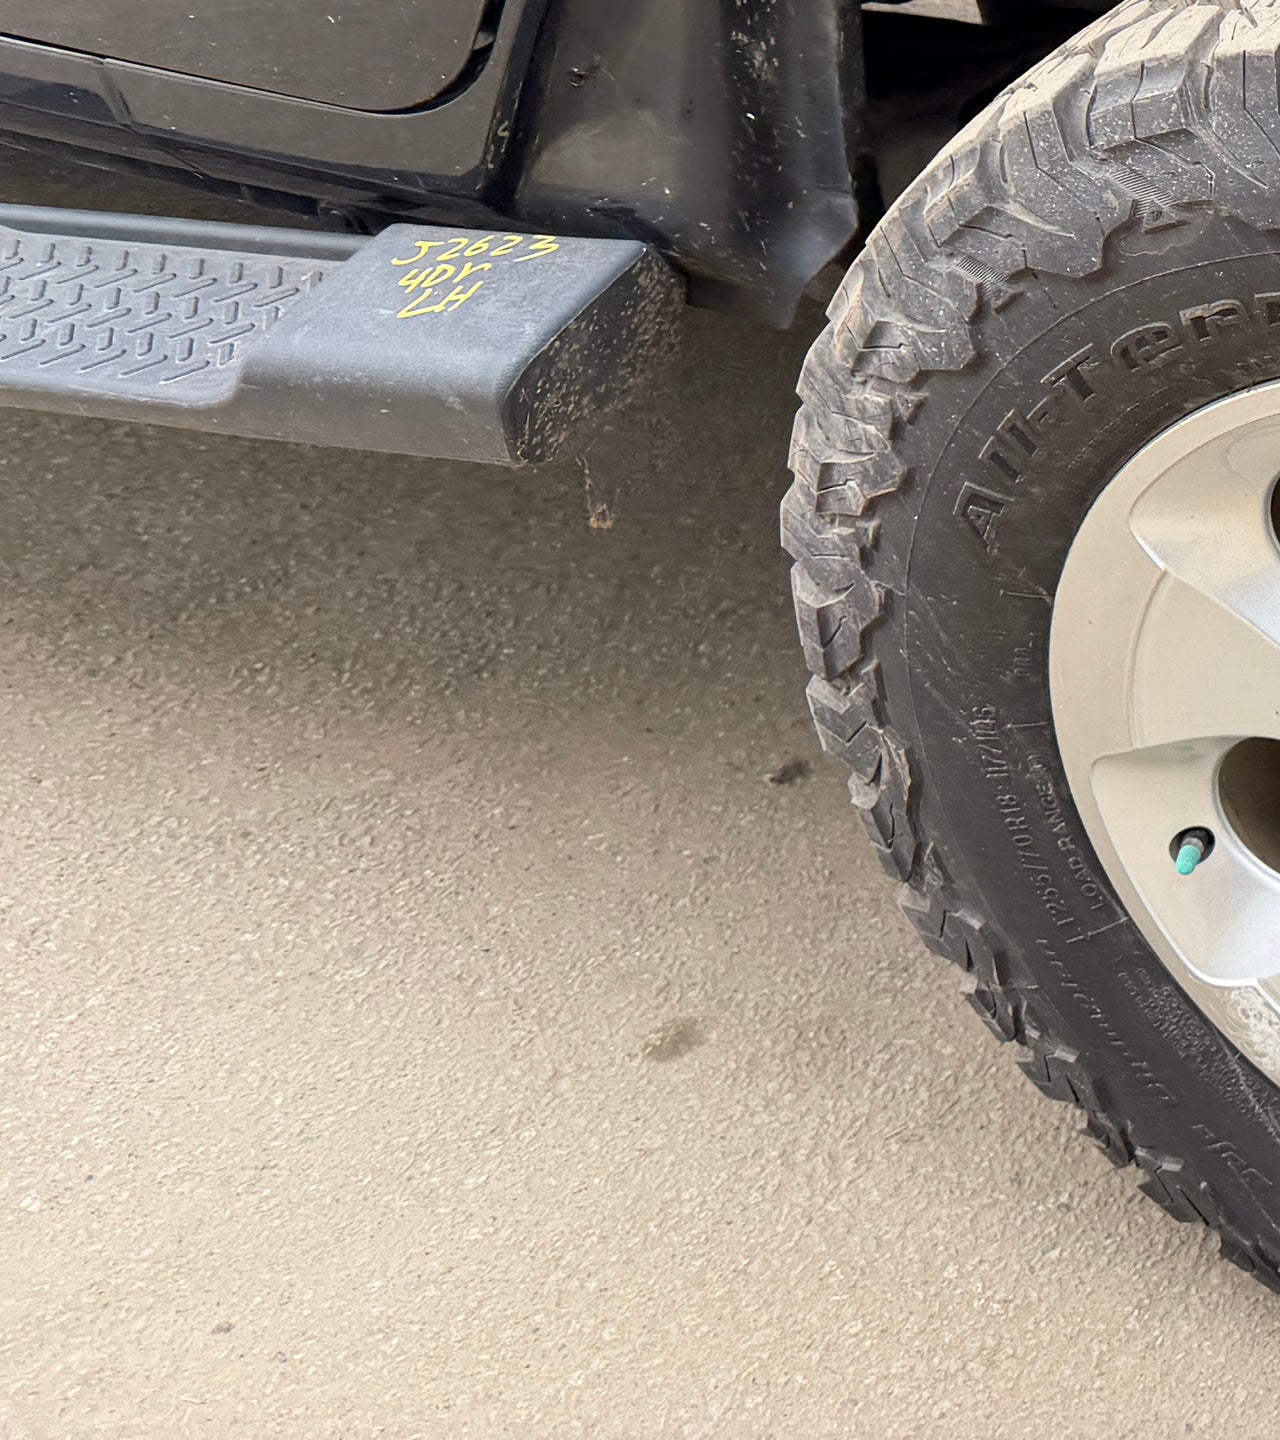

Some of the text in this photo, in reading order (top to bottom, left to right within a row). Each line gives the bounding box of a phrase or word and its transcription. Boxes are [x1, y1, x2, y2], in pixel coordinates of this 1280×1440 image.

[391, 235, 559, 265] J2623
[397, 281, 484, 319] LH
[1067, 856, 1104, 909] LOAD
